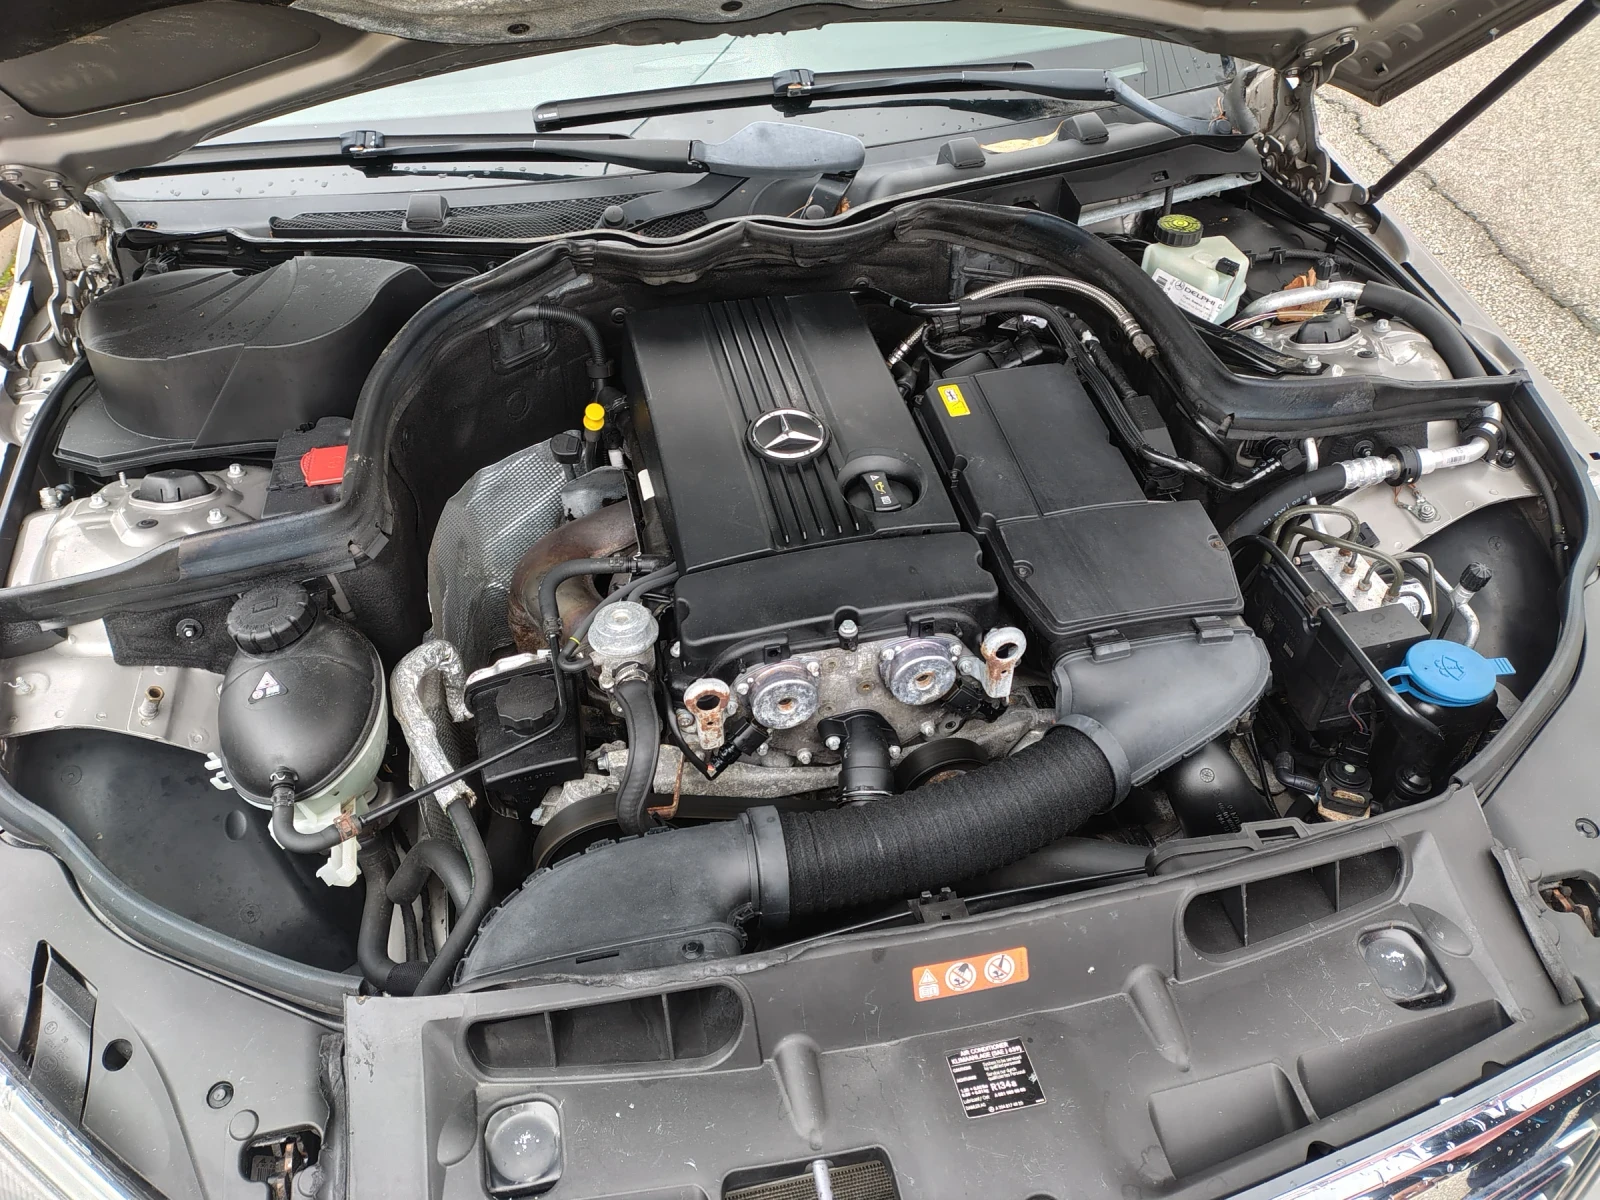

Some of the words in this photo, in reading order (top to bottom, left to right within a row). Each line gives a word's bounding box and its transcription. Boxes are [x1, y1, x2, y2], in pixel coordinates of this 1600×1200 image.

[1184, 286, 1216, 306] DELPHI
[960, 1049, 970, 1057] AIR
[970, 1041, 1009, 1055] CONDITIONER
[951, 1052, 991, 1065] KLIMAANLAGE
[990, 1080, 1018, 1091] R134a
